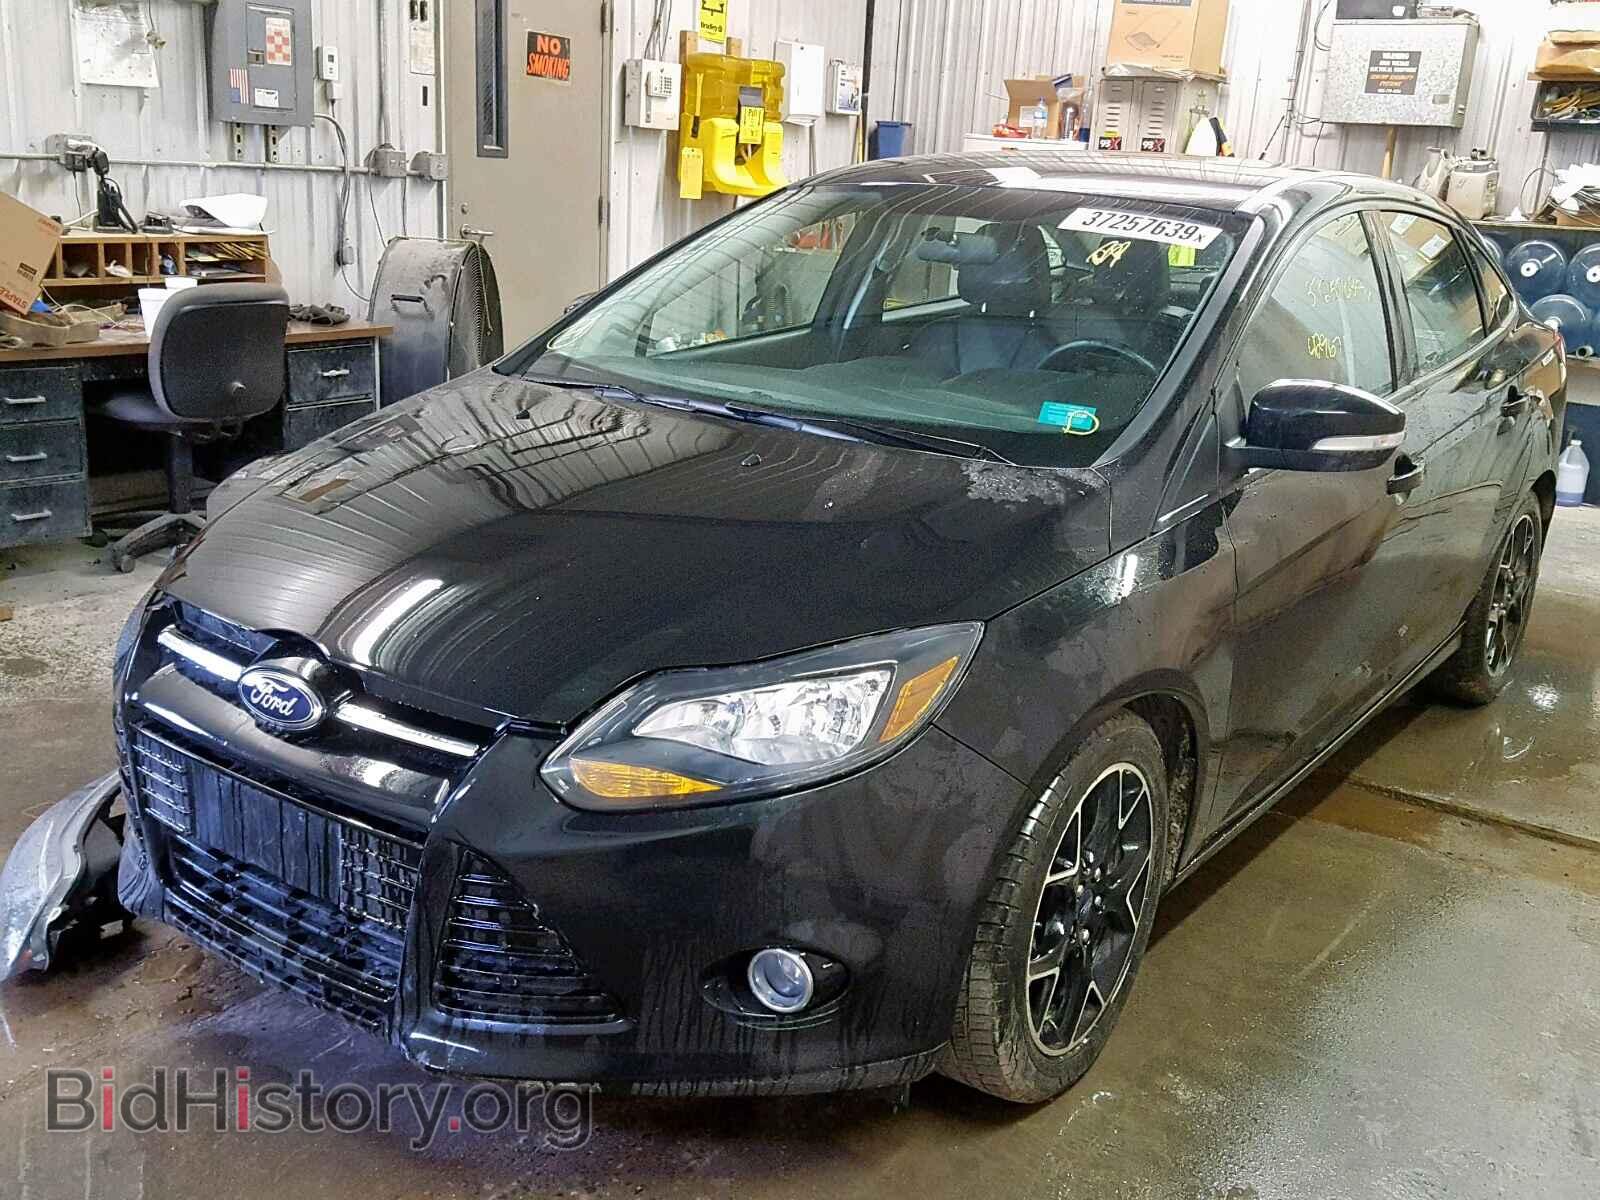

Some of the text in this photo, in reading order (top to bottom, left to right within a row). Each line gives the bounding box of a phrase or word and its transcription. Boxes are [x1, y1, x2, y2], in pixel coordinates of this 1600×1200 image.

[537, 35, 561, 55] NO
[527, 52, 570, 81] SMOKING
[249, 675, 298, 717] Ford
